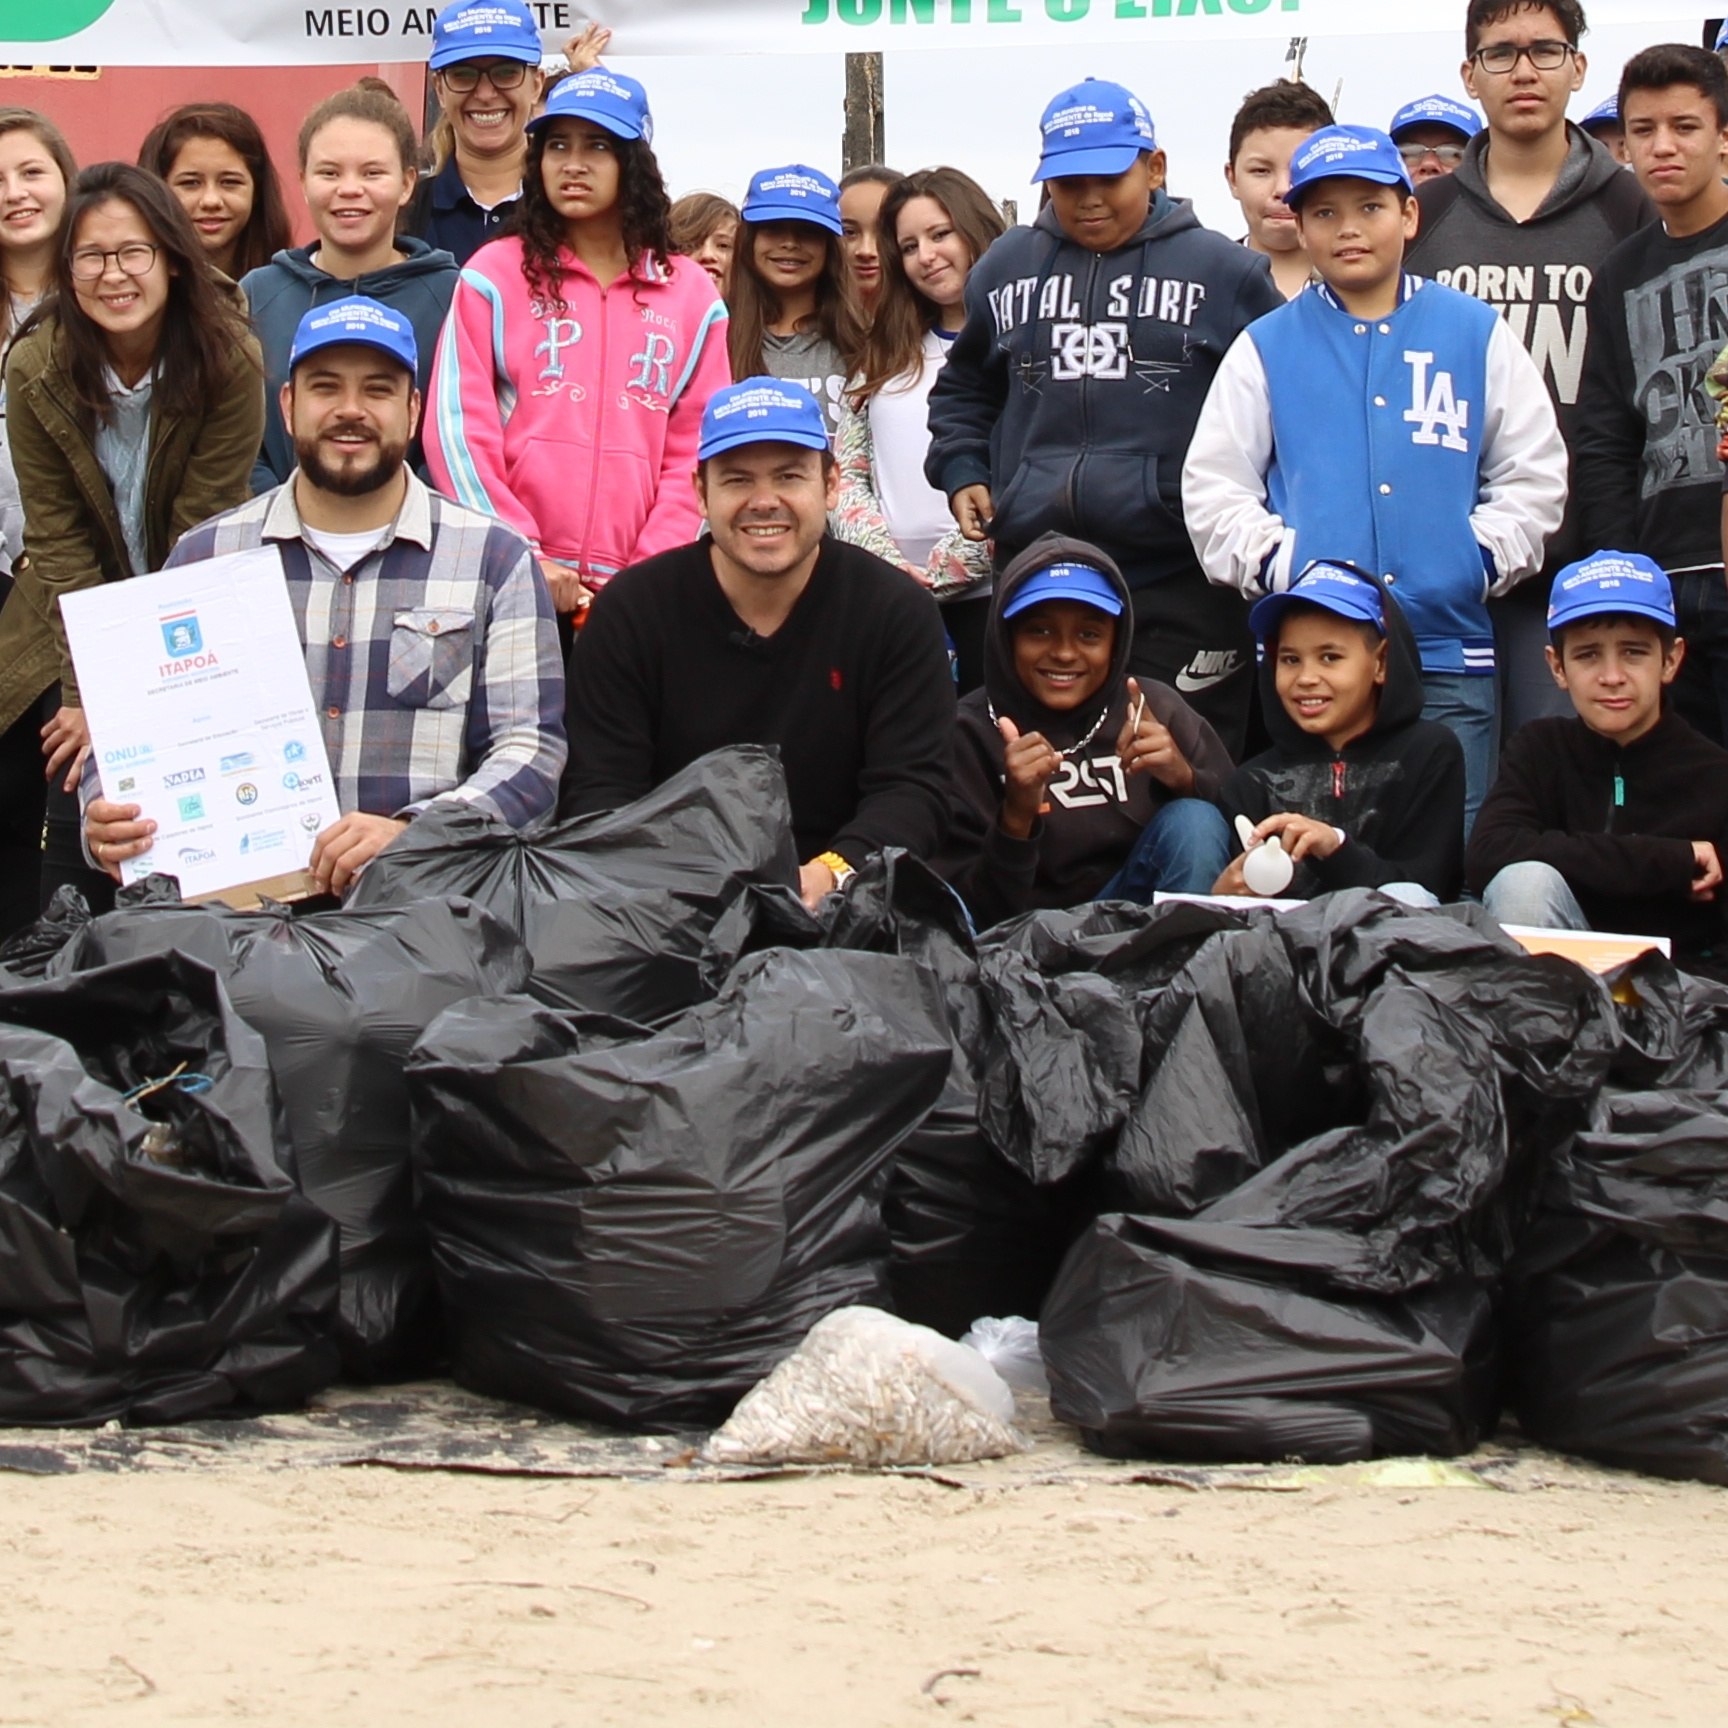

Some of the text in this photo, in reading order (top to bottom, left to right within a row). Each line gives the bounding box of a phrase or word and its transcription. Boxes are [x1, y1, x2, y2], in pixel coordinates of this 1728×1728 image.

[305, 8, 390, 37] MEIO
[1544, 264, 1593, 302] TO
[987, 272, 1081, 337] FATAL
[534, 316, 583, 382] P
[626, 331, 676, 398] R
[1403, 350, 1468, 453] LA
[157, 649, 219, 678] ITAPOÁ
[1188, 649, 1238, 675] NIKE
[103, 745, 138, 765] ONU
